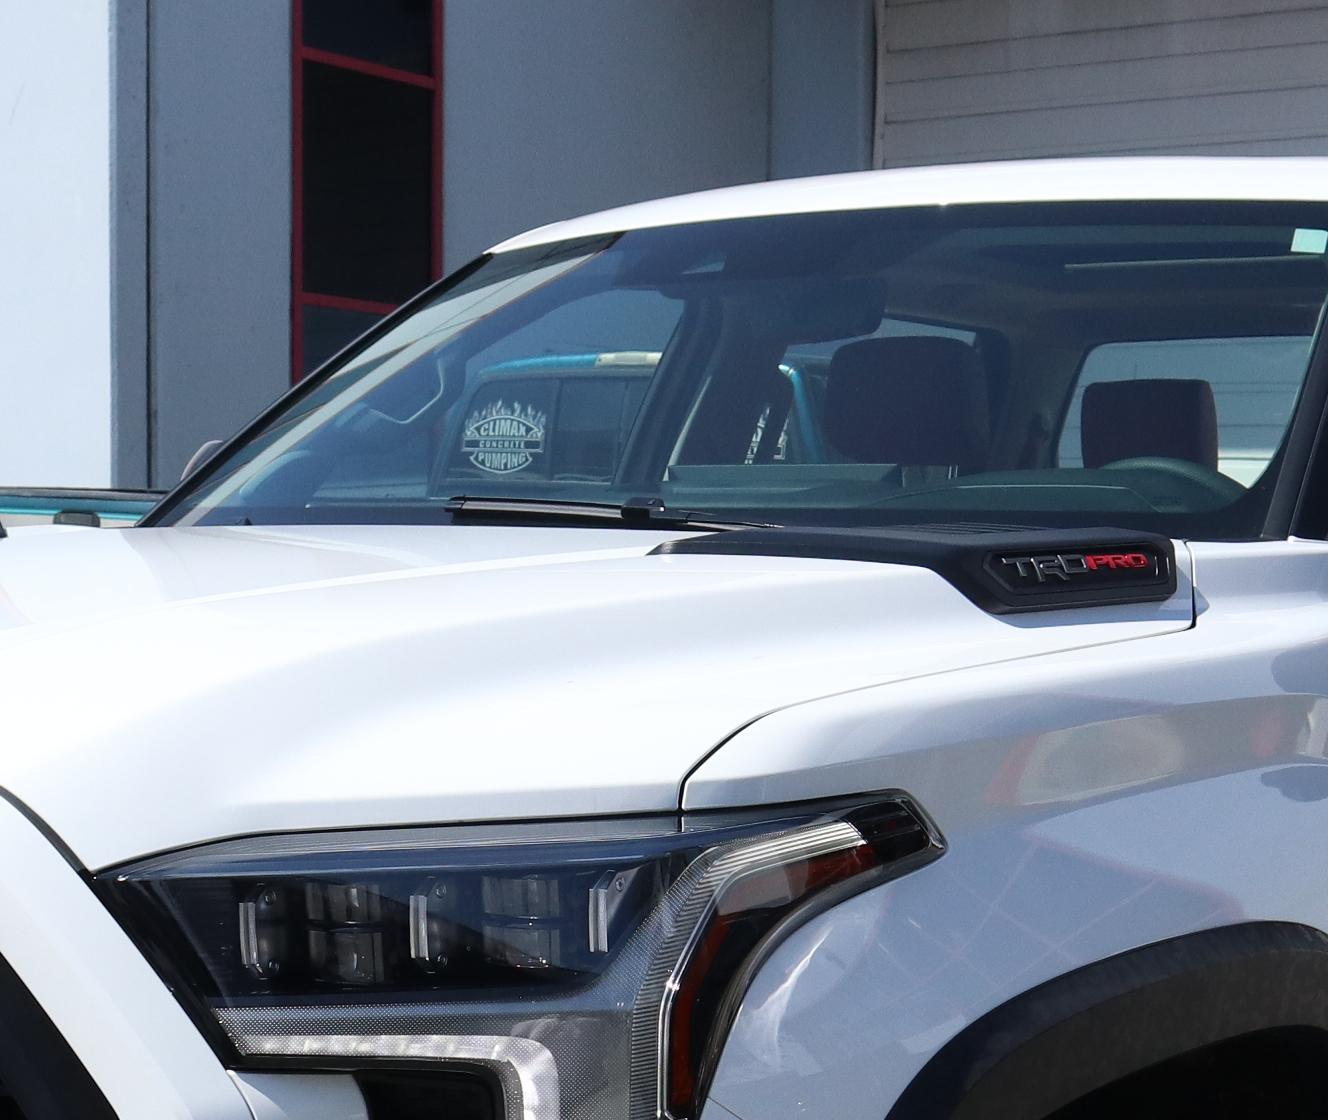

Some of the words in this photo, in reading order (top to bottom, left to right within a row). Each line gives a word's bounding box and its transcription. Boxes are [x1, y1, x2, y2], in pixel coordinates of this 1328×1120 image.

[479, 419, 527, 437] CLIMAX
[479, 440, 525, 449] CONCRETE
[477, 452, 527, 470] PUMPING
